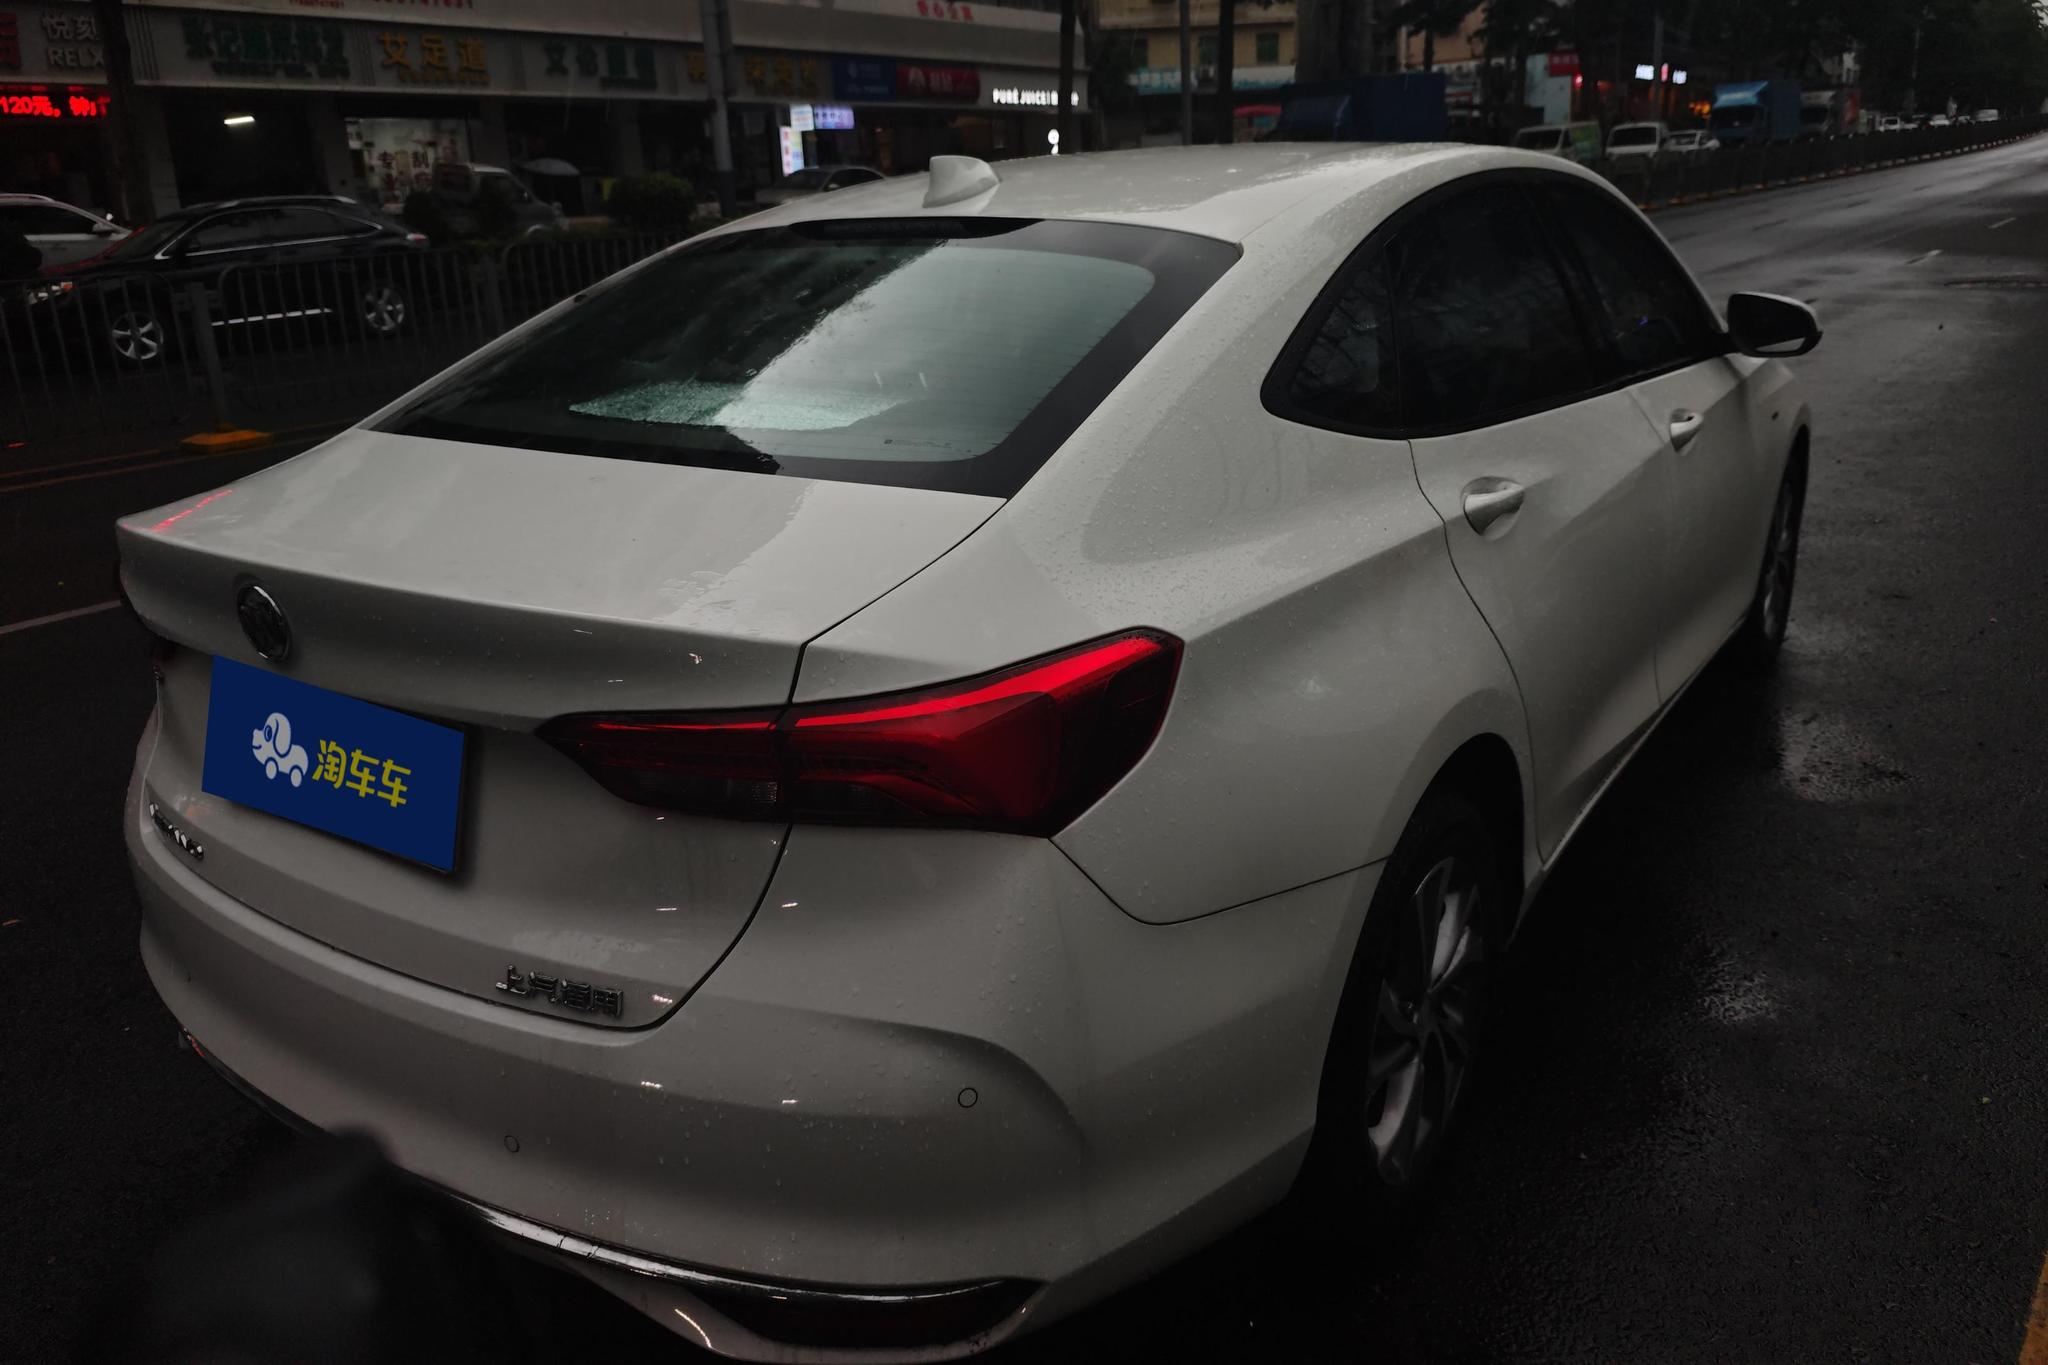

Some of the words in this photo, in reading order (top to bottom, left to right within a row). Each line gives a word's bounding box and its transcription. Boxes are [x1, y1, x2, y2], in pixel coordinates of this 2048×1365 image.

[48, 46, 105, 67] RELX
[495, 963, 624, 1016] 上汽通用
